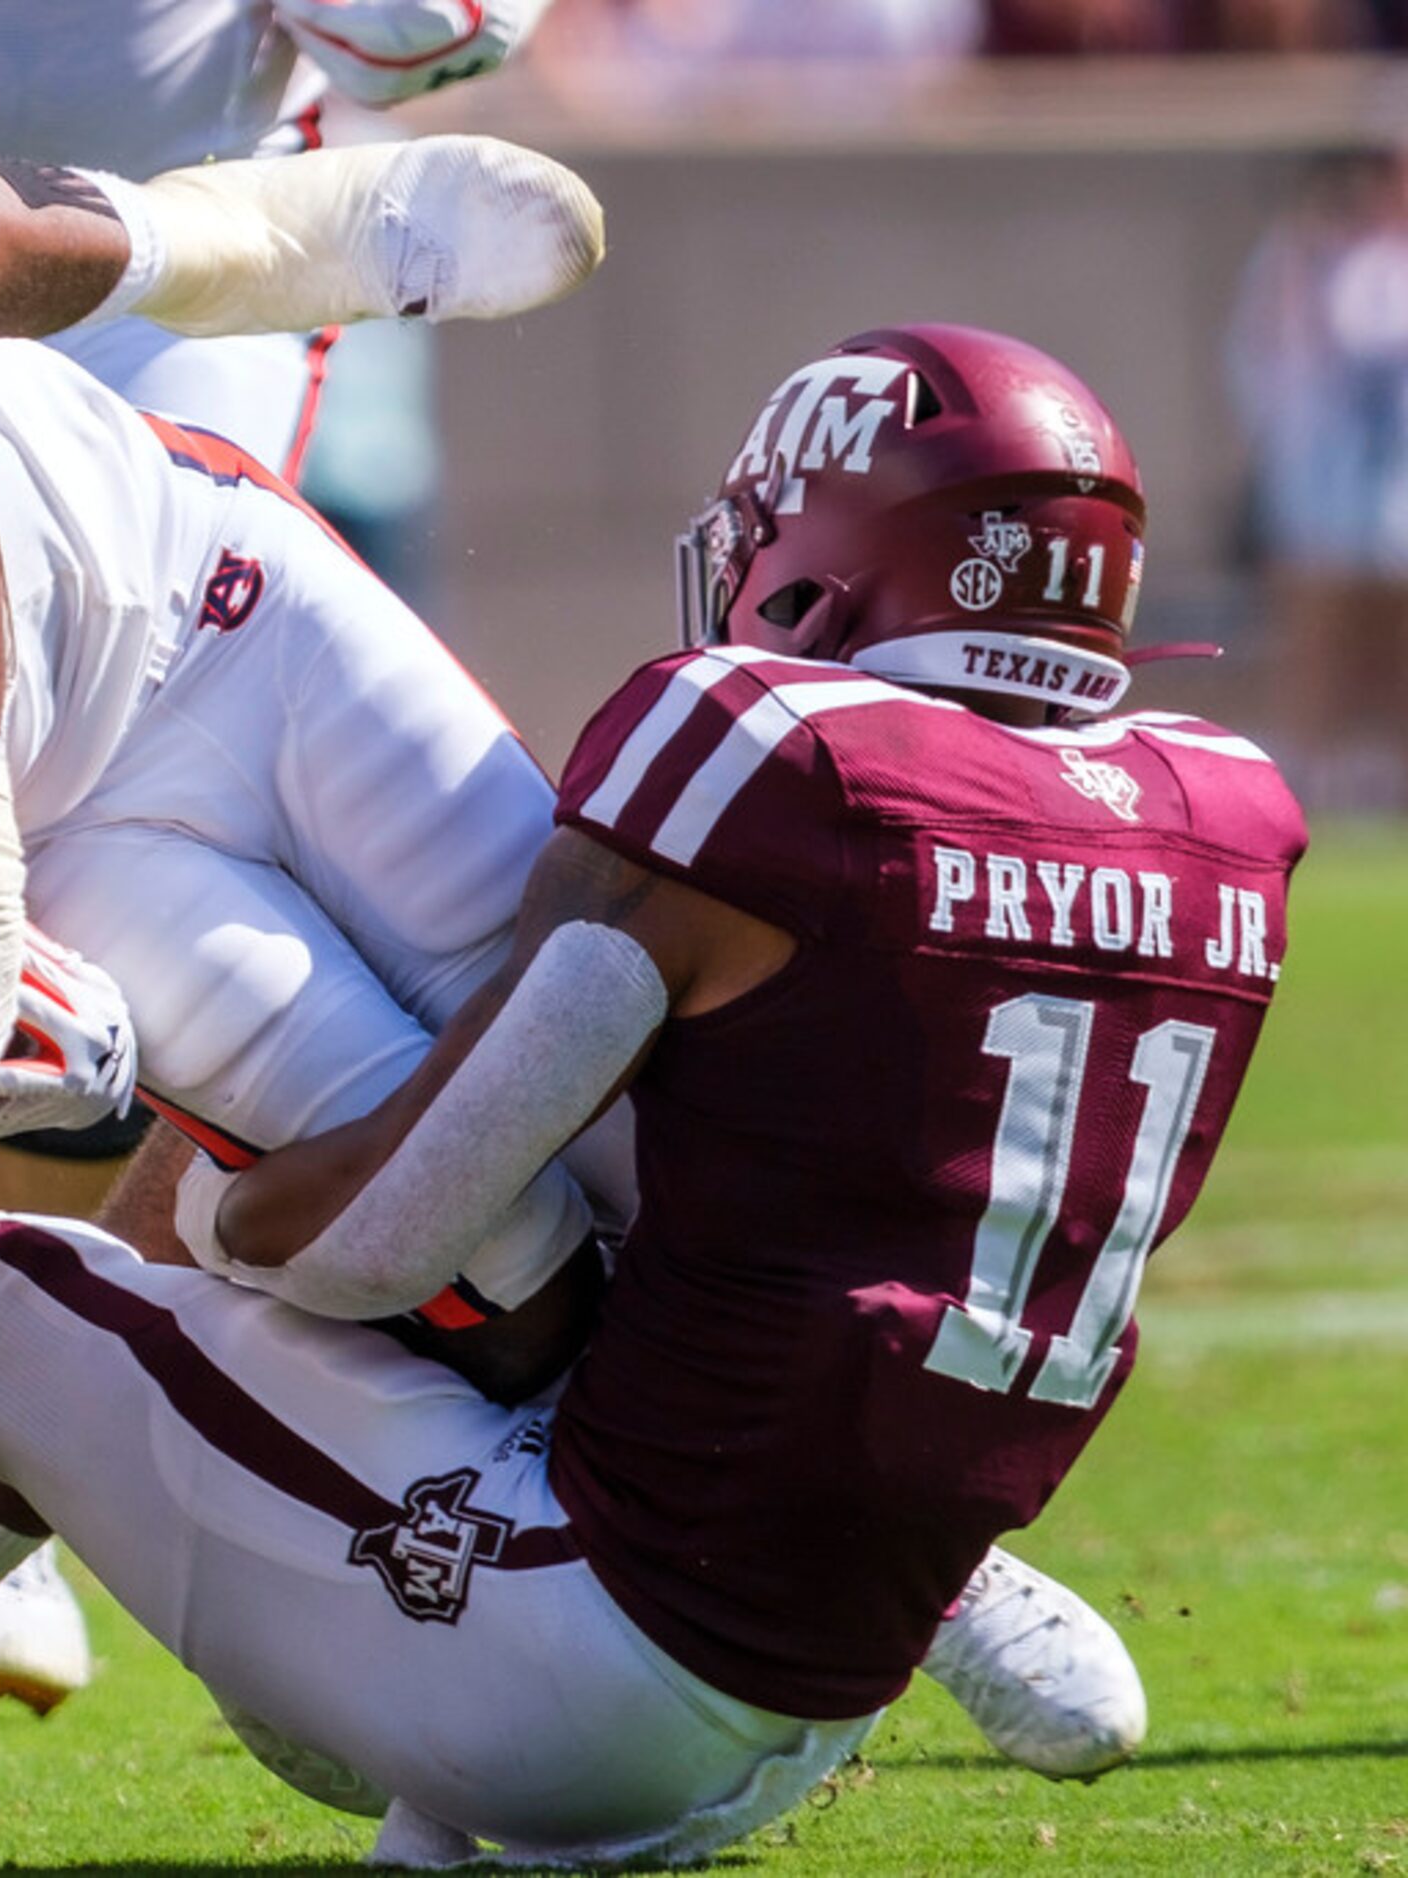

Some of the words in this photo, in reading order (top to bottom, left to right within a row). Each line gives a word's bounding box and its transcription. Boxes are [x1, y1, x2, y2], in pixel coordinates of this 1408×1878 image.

[954, 561, 999, 607] SEC
[1043, 536, 1105, 608] 11
[962, 643, 1070, 691] TEXAS
[928, 845, 1176, 959] PRYOR
[1205, 882, 1281, 982] JR.
[922, 991, 1217, 1411] 11
